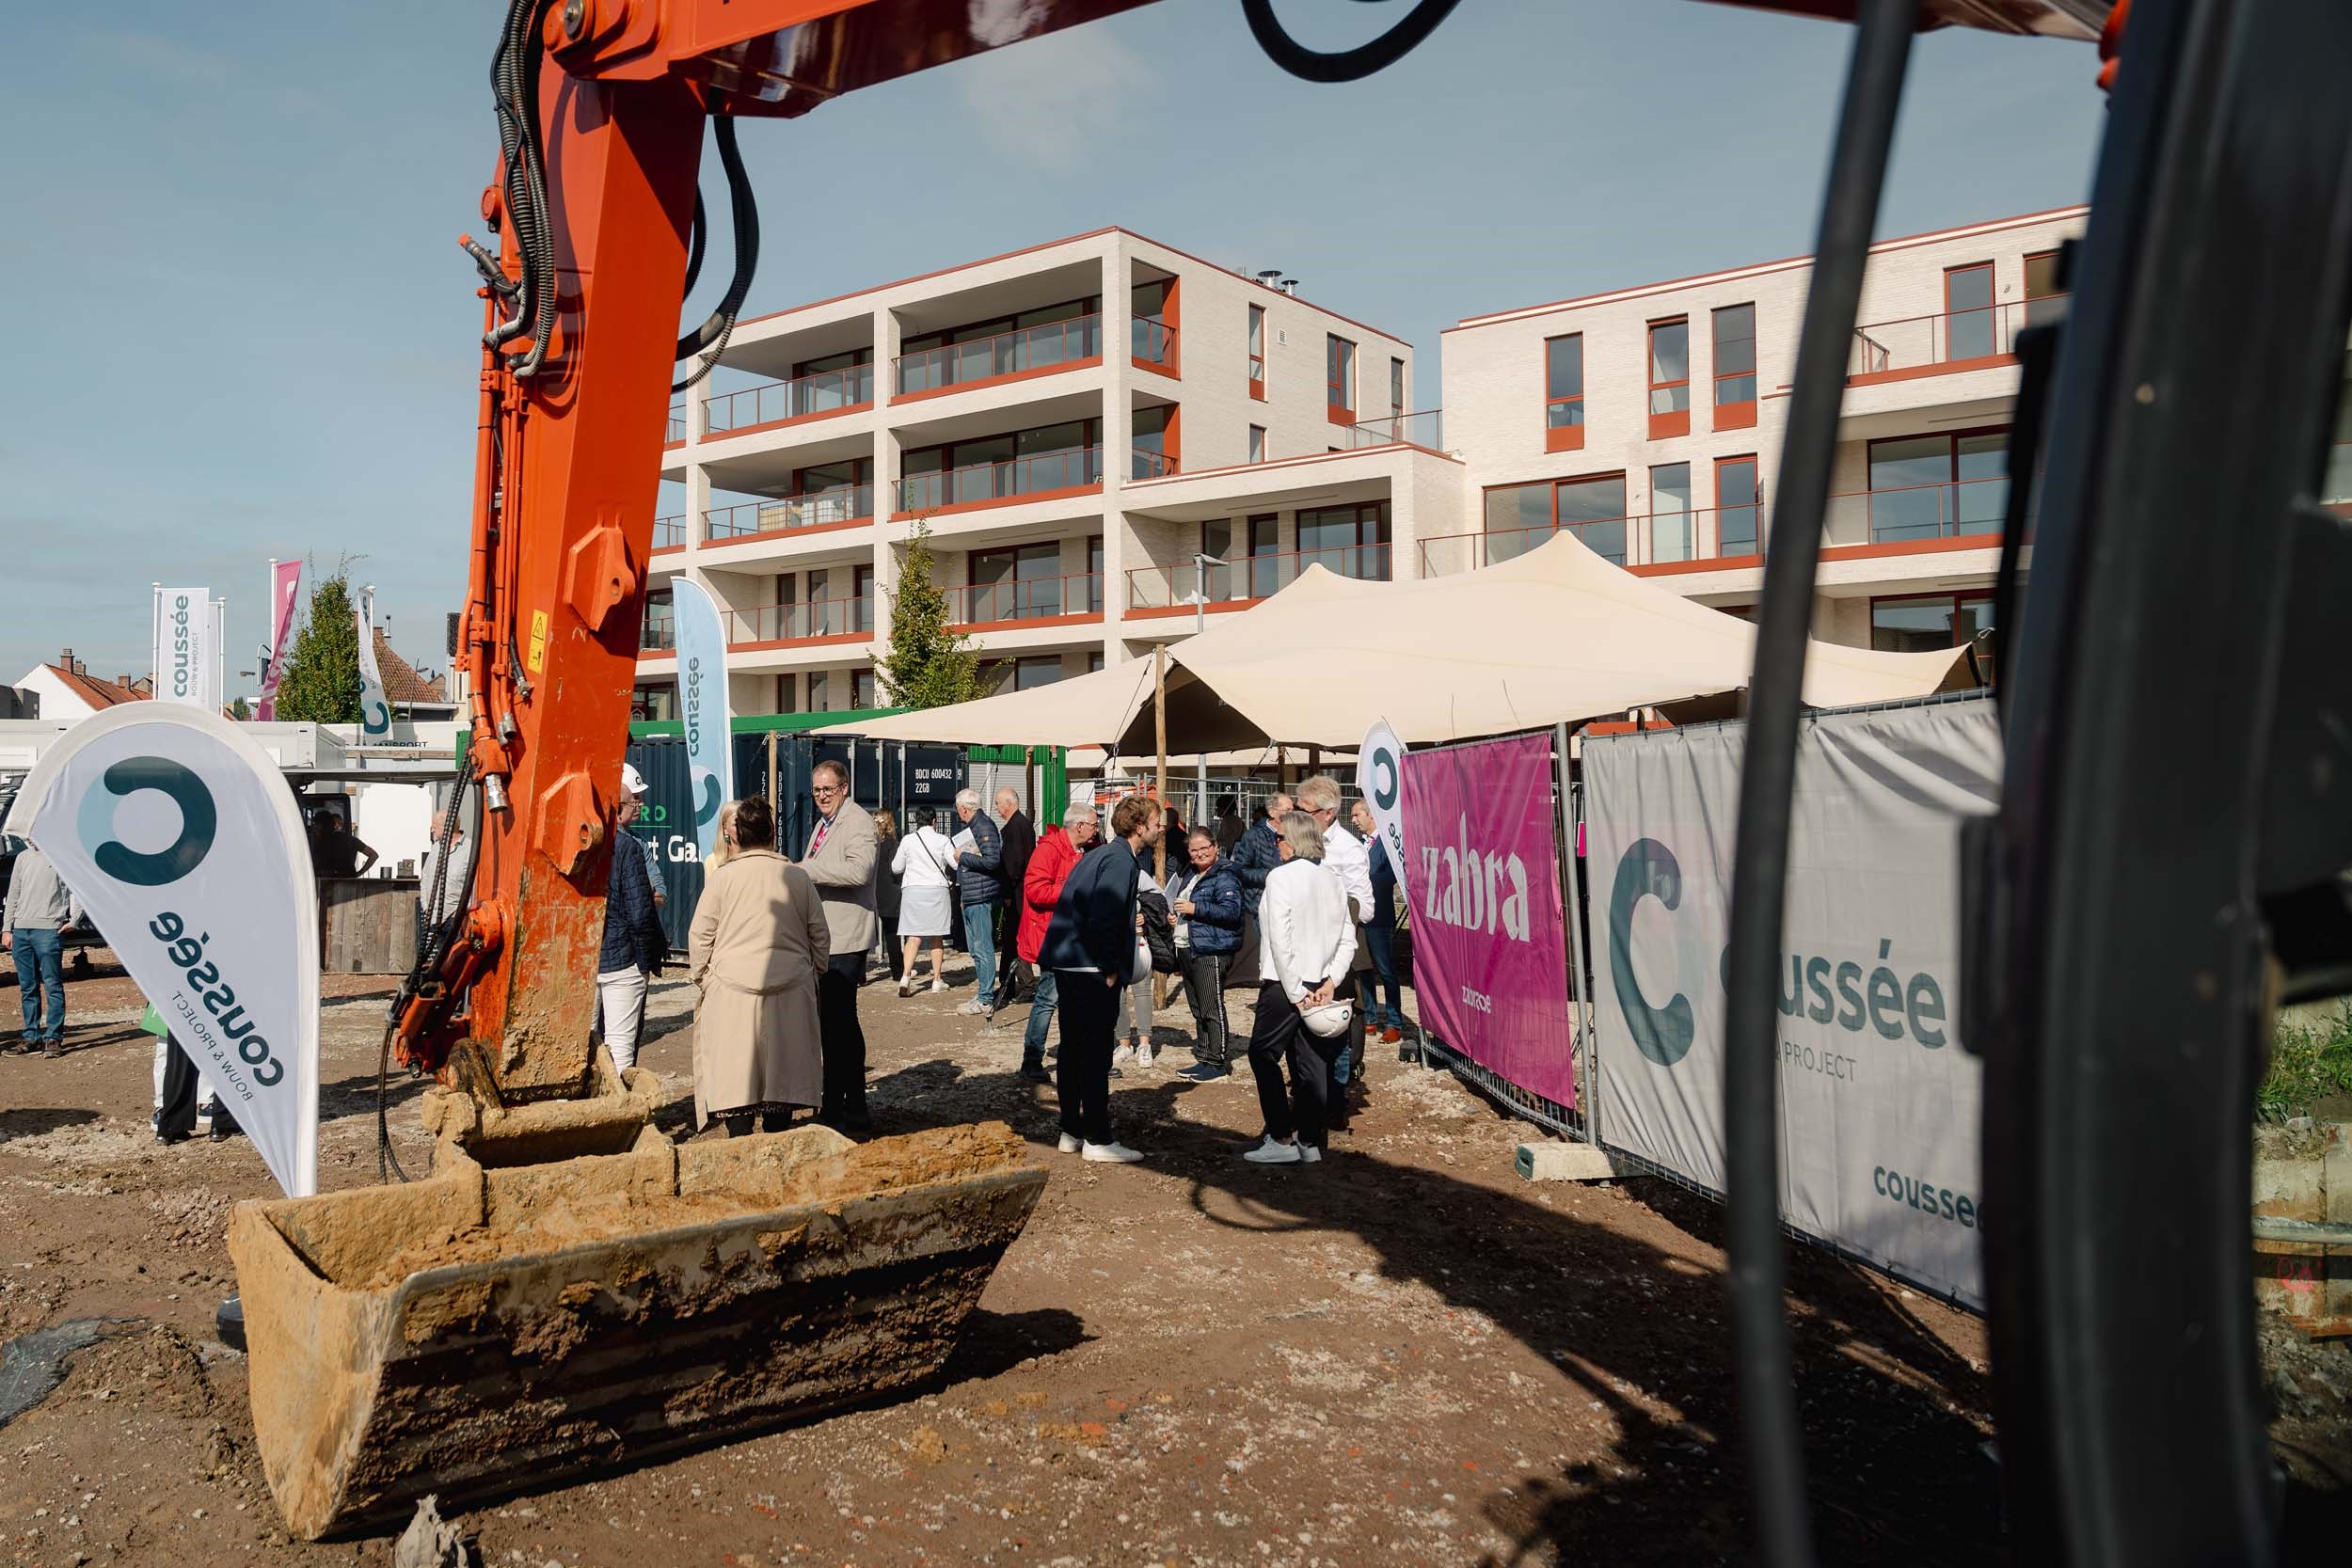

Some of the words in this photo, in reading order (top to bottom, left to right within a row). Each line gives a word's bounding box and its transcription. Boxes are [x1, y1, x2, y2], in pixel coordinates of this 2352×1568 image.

[170, 594, 188, 698] coussée
[1422, 810, 1530, 942] zabra
[1720, 938, 1947, 1050] ussée
[1785, 1040, 1857, 1083] PROJECT
